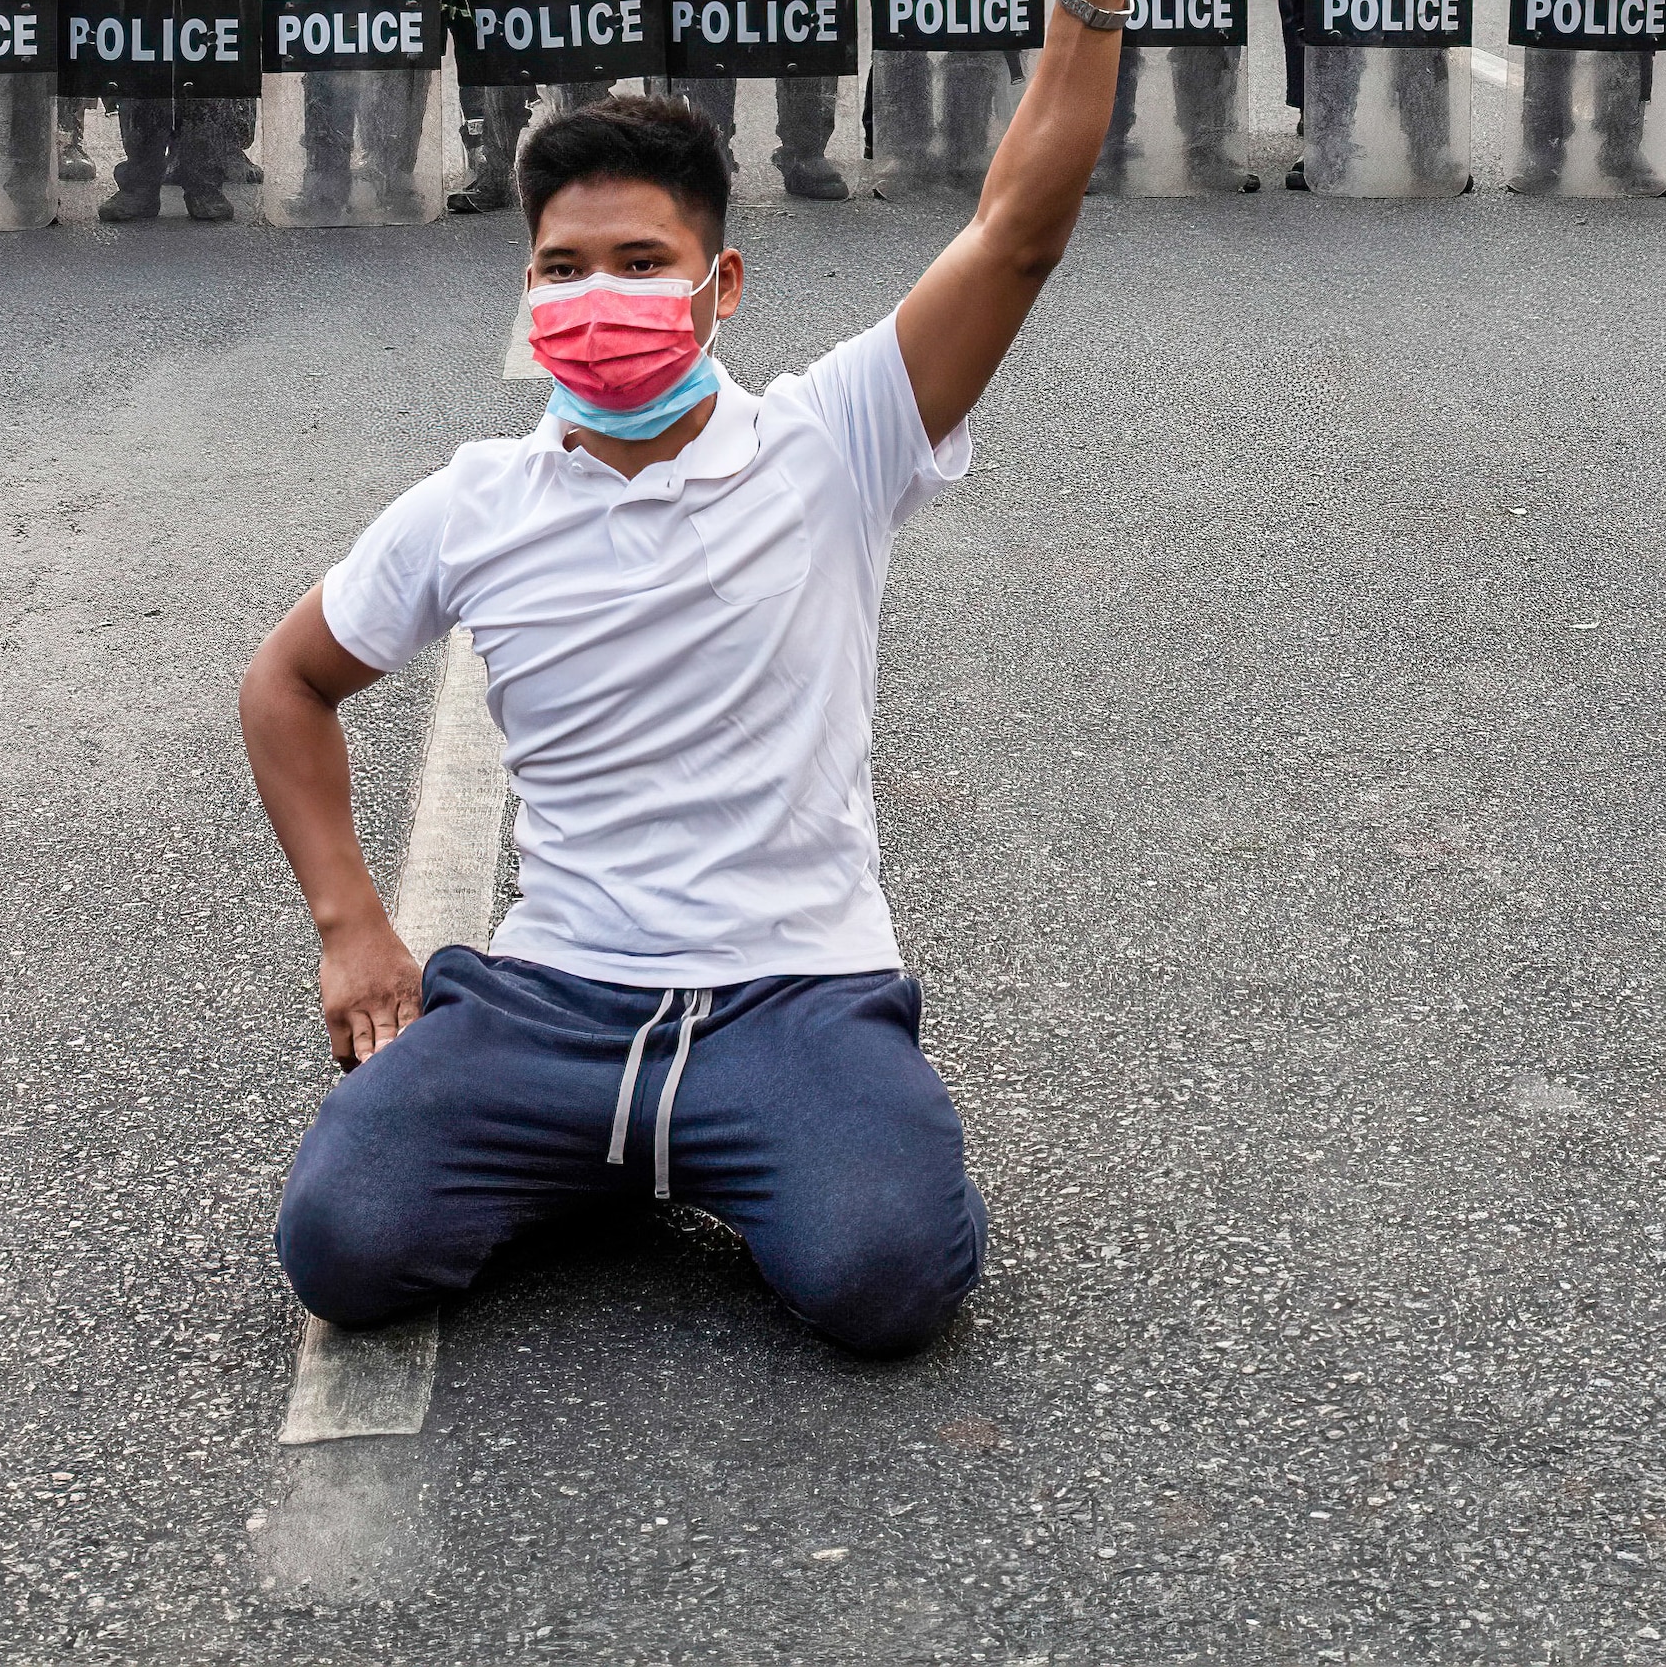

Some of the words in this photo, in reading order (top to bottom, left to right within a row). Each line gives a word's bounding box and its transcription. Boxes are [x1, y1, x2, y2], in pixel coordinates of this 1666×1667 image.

[70, 17, 239, 61] POLICE
[278, 10, 423, 55] POLICE
[475, 0, 643, 50] POLICE
[672, 0, 837, 44] POLICE
